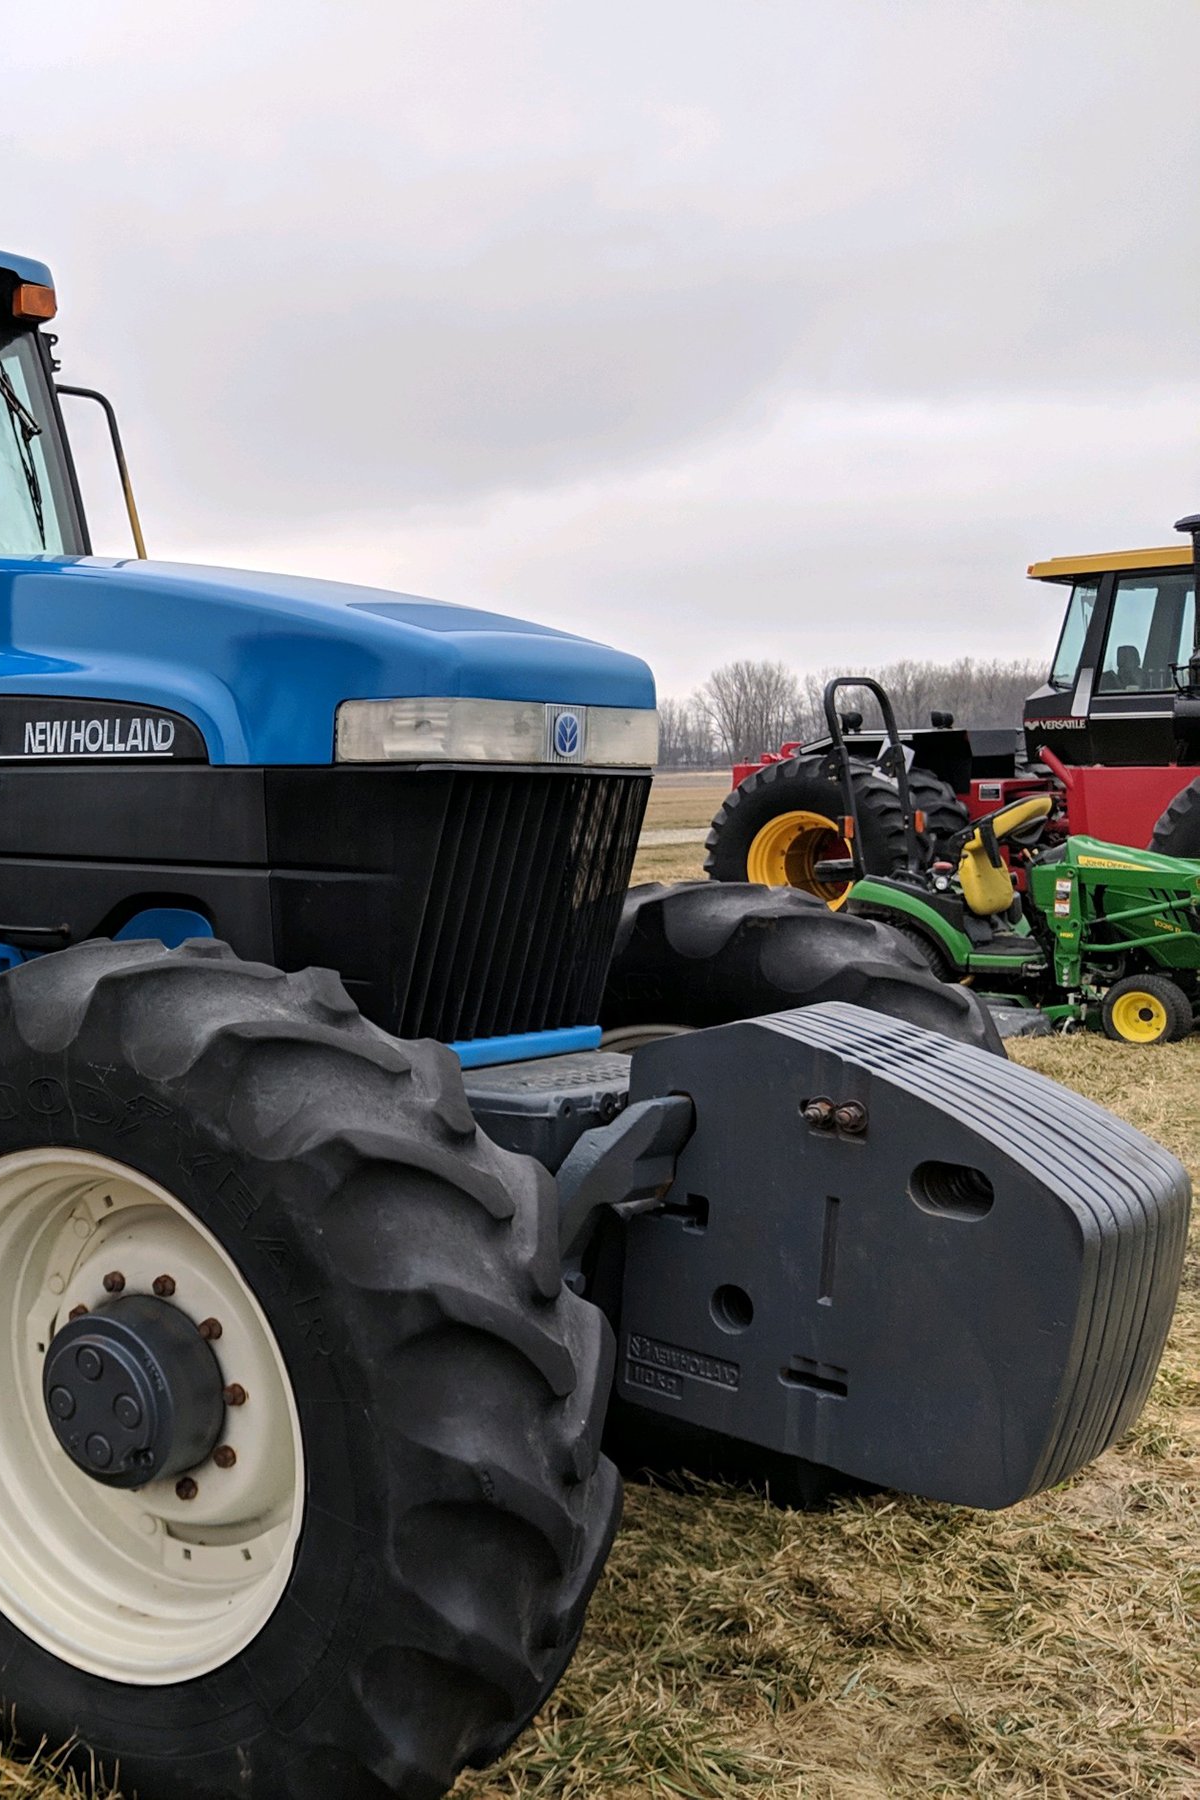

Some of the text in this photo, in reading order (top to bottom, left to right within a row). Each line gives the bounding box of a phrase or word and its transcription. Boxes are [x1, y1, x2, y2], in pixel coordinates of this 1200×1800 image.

[1040, 719, 1086, 730] VERSATILE
[24, 719, 68, 754] NEW
[69, 718, 175, 752] HOLLAND
[1084, 858, 1106, 867] JOHN
